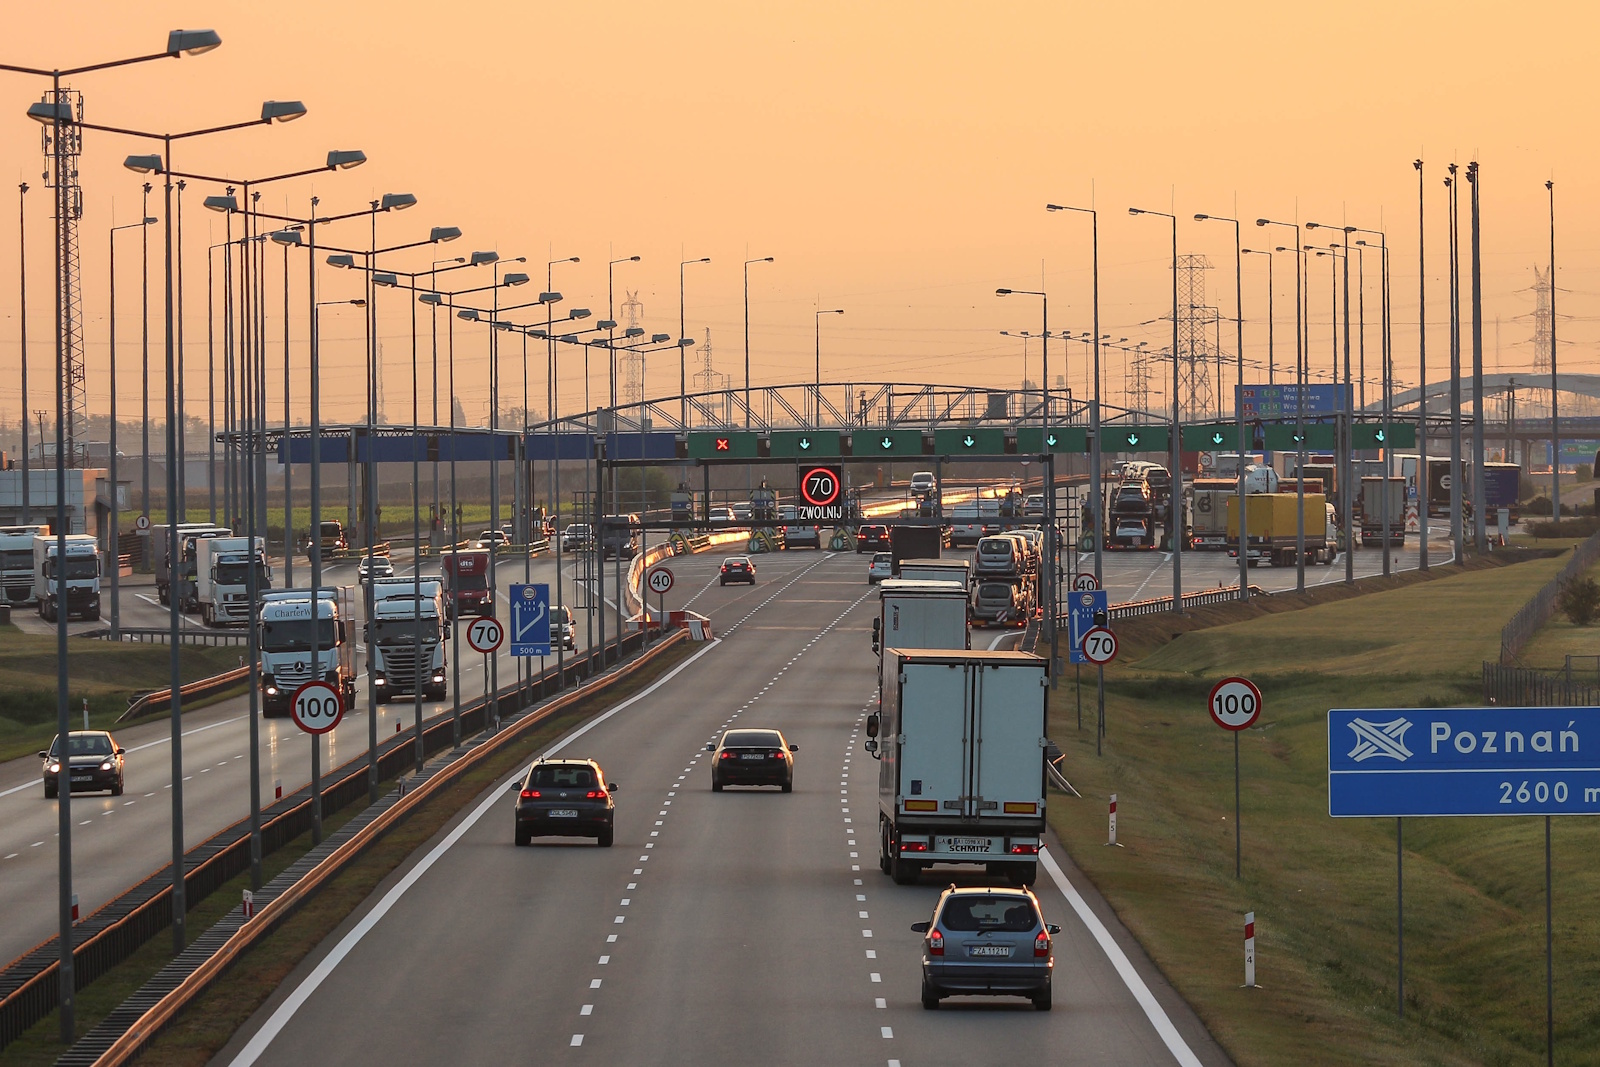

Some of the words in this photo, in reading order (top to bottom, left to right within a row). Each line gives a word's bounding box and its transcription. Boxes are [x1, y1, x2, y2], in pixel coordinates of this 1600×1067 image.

[810, 477, 832, 495] 70
[1409, 487, 1415, 495] P
[800, 506, 842, 519] ZWOLNIJ
[652, 575, 670, 587] 40
[1077, 579, 1095, 591] 40
[274, 608, 320, 618] CharterW
[475, 626, 498, 643] 70
[1090, 637, 1113, 655] 70
[297, 697, 337, 718] 100
[1215, 694, 1254, 715] 100
[1431, 720, 1579, 753] Poznań
[1499, 781, 1568, 803] 2600
[1584, 787, 1600, 803] m
[949, 845, 990, 853] SCHMITZ
[1246, 956, 1252, 964] 4
